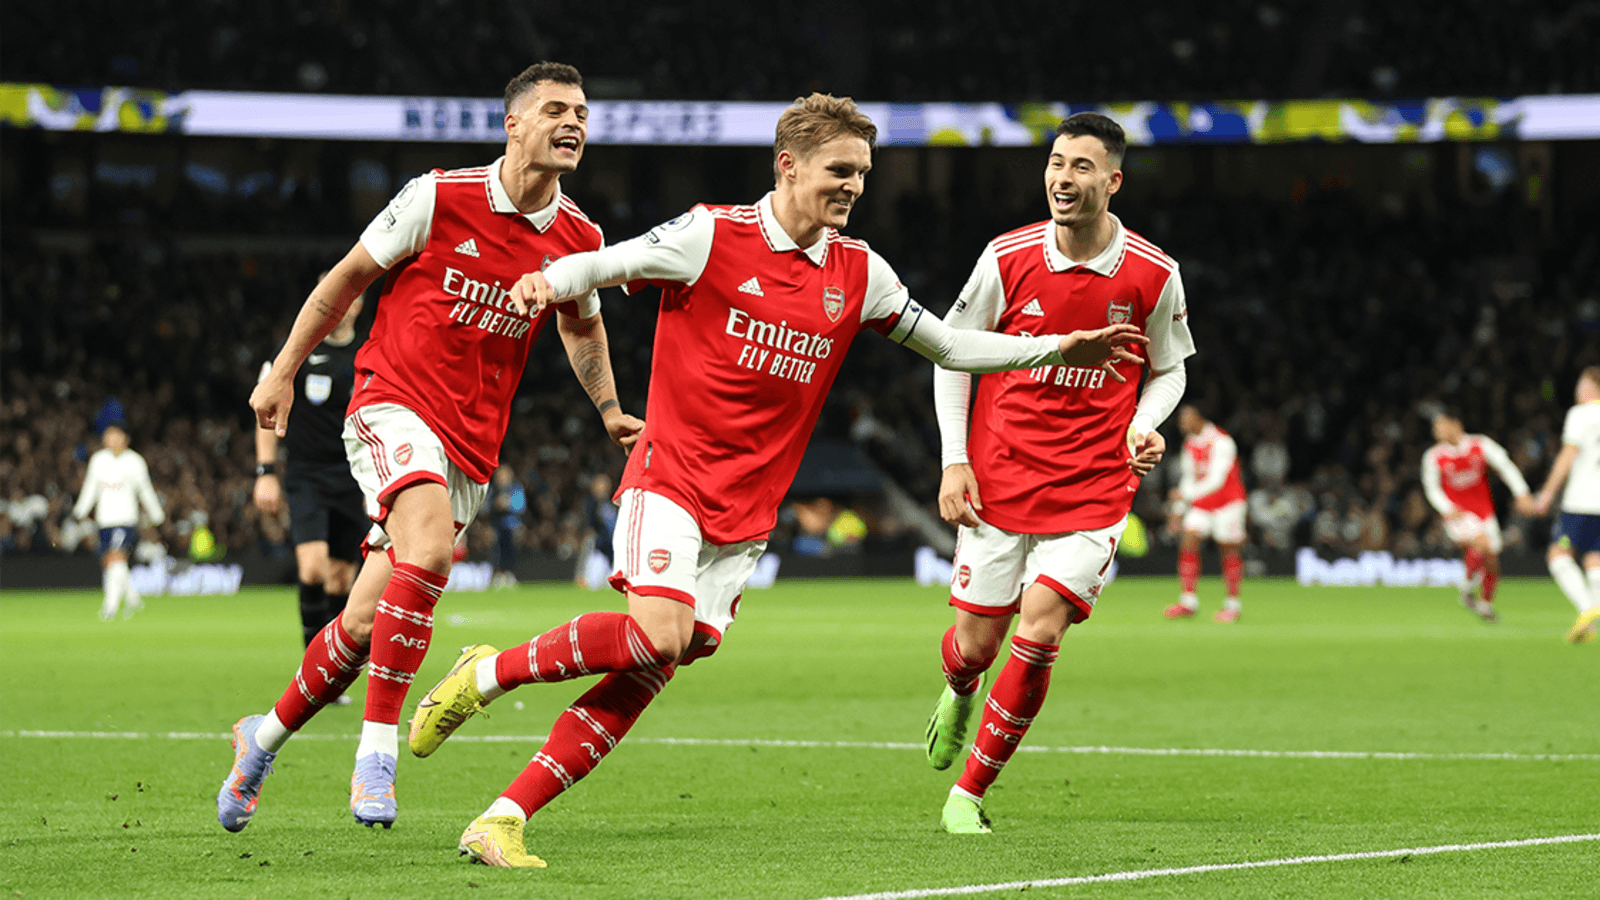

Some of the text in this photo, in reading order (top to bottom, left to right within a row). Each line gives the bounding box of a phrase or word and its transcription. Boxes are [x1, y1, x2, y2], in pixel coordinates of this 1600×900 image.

[449, 299, 531, 339] FLY BETTER
[725, 307, 834, 359] Emirates
[737, 344, 817, 384] FLY BETTER
[1054, 366, 1107, 389] BETTER
[390, 633, 426, 650] AFC
[985, 722, 1020, 744] AFC
